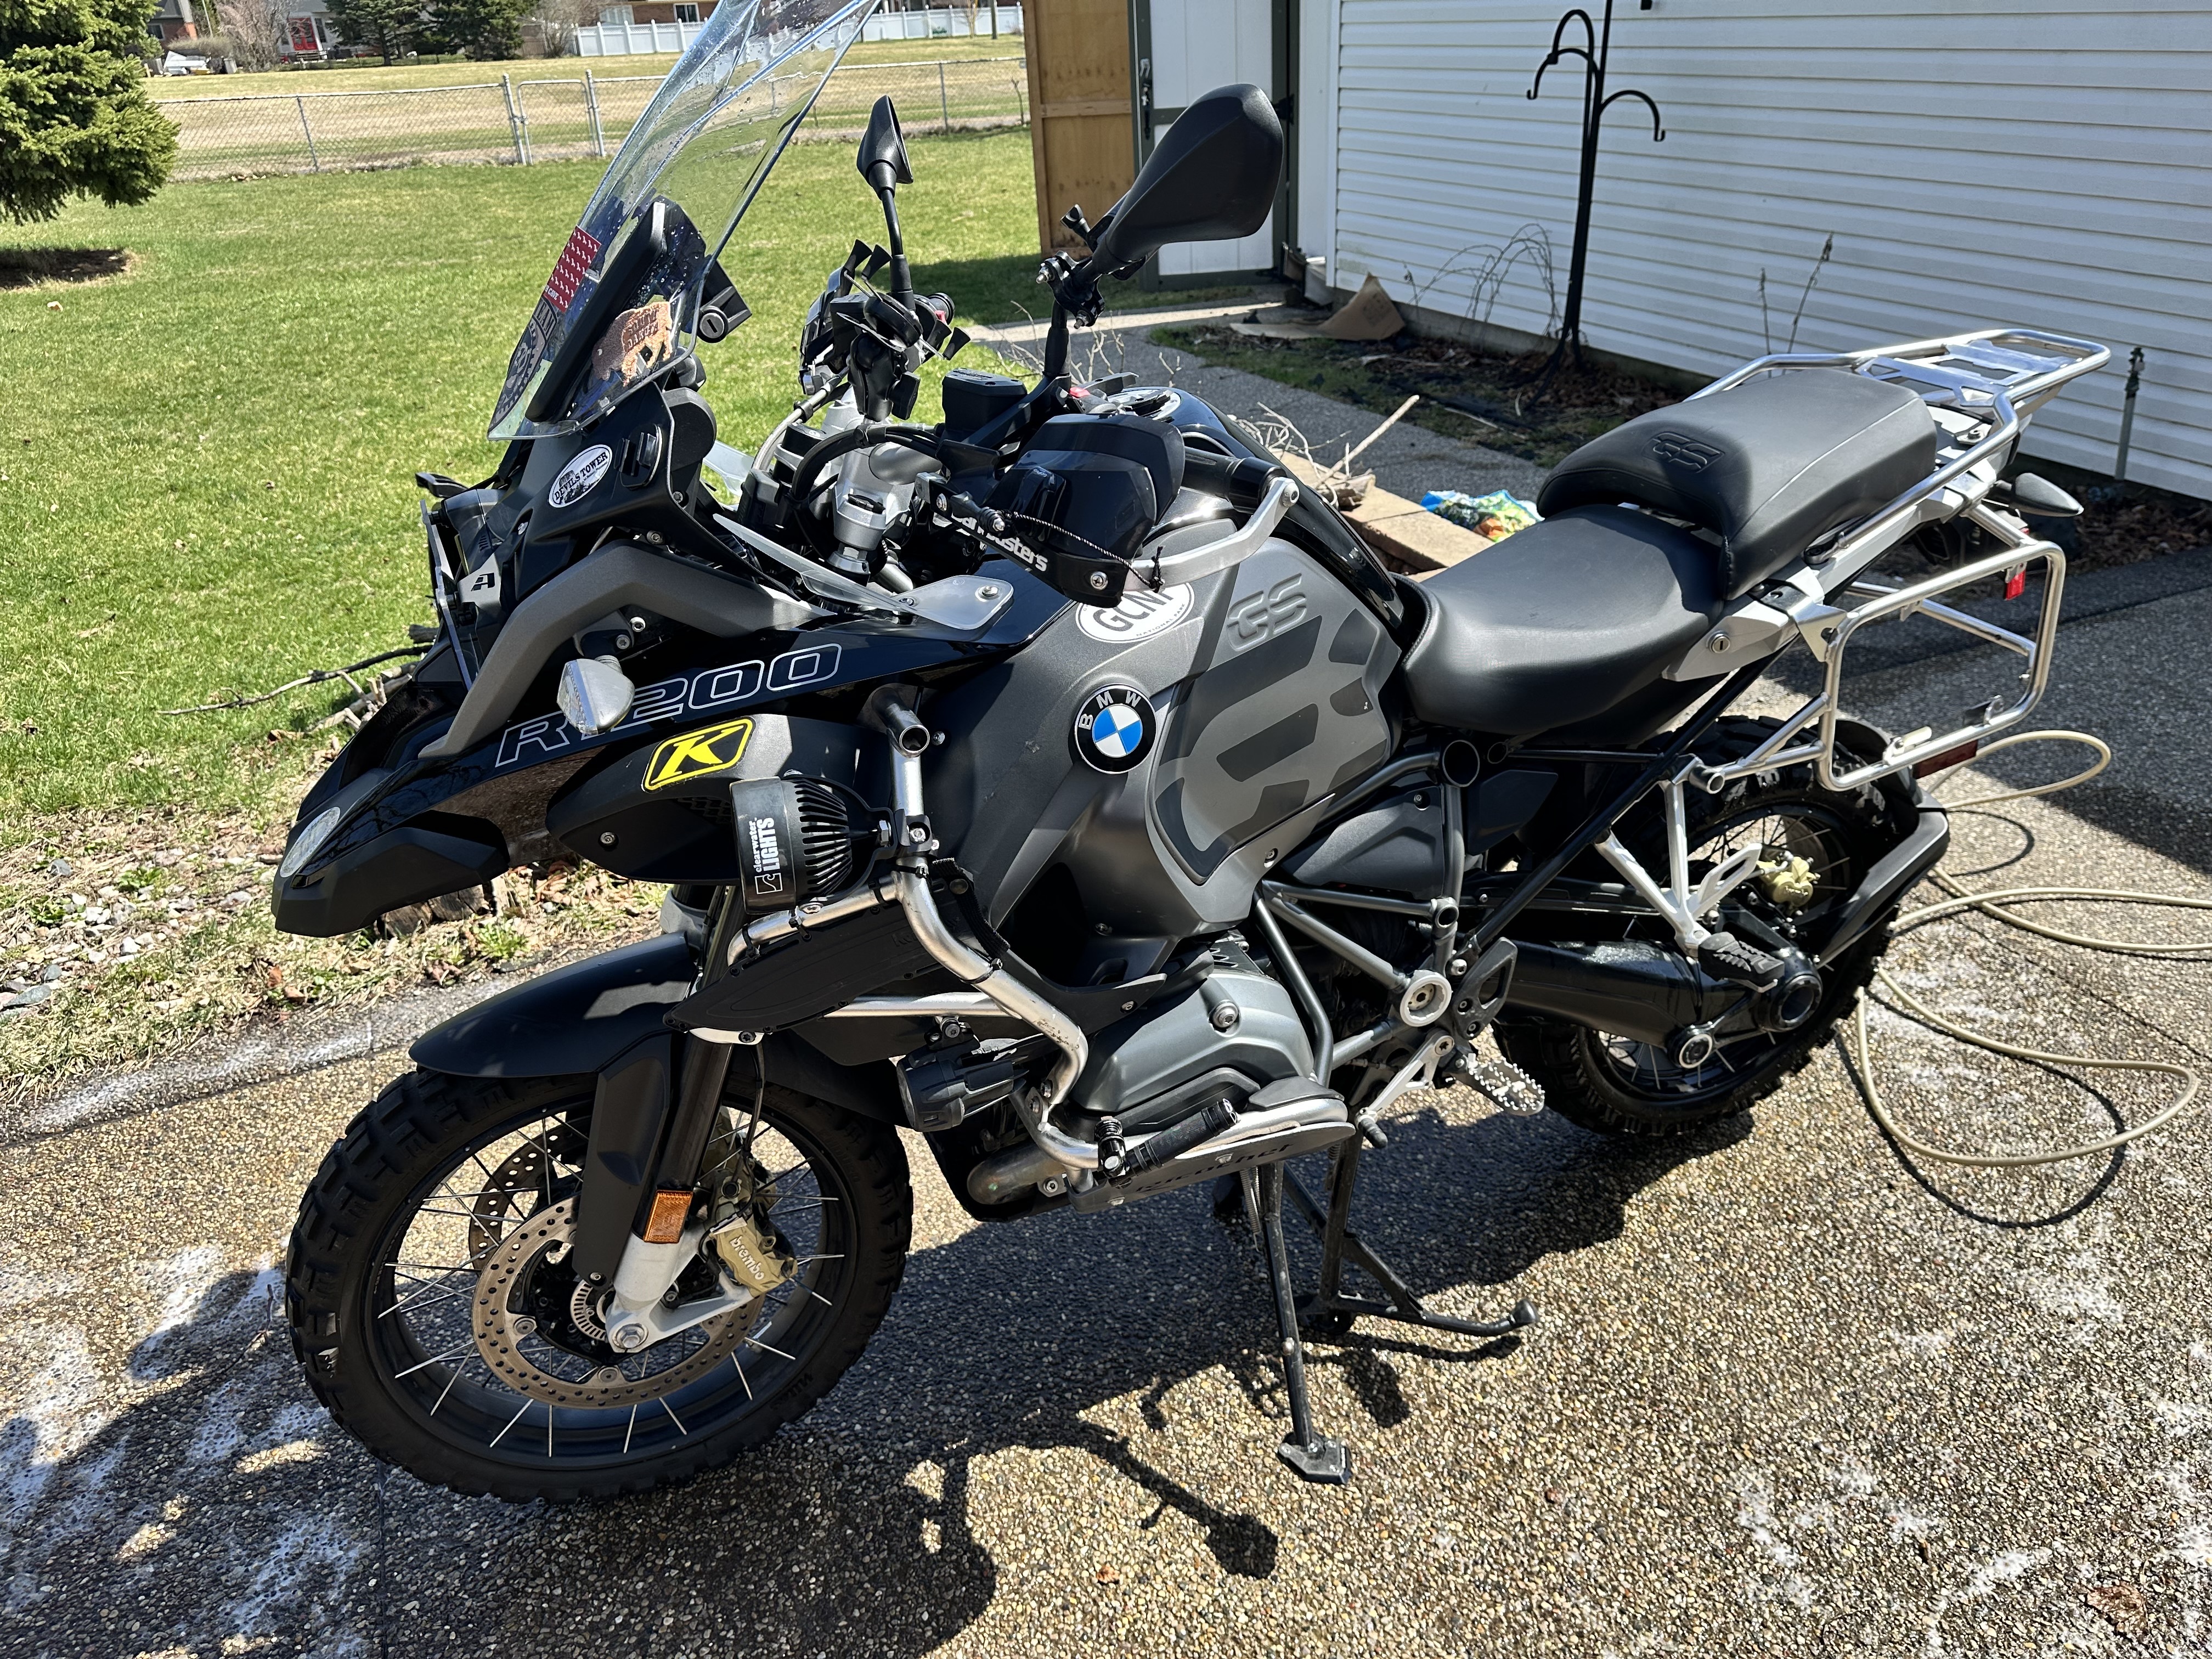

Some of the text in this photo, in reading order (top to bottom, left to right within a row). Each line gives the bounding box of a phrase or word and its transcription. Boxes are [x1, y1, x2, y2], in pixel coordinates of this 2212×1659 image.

[554, 472, 580, 500] DEVILS
[579, 452, 608, 477] TOWER
[1136, 603, 1185, 636] NATIONAL PARK
[1226, 573, 1307, 652] GS
[1079, 690, 1142, 730] BMW
[749, 820, 762, 873] clearwater
[756, 817, 780, 871] LIGHTS
[730, 1235, 765, 1280] brembo
